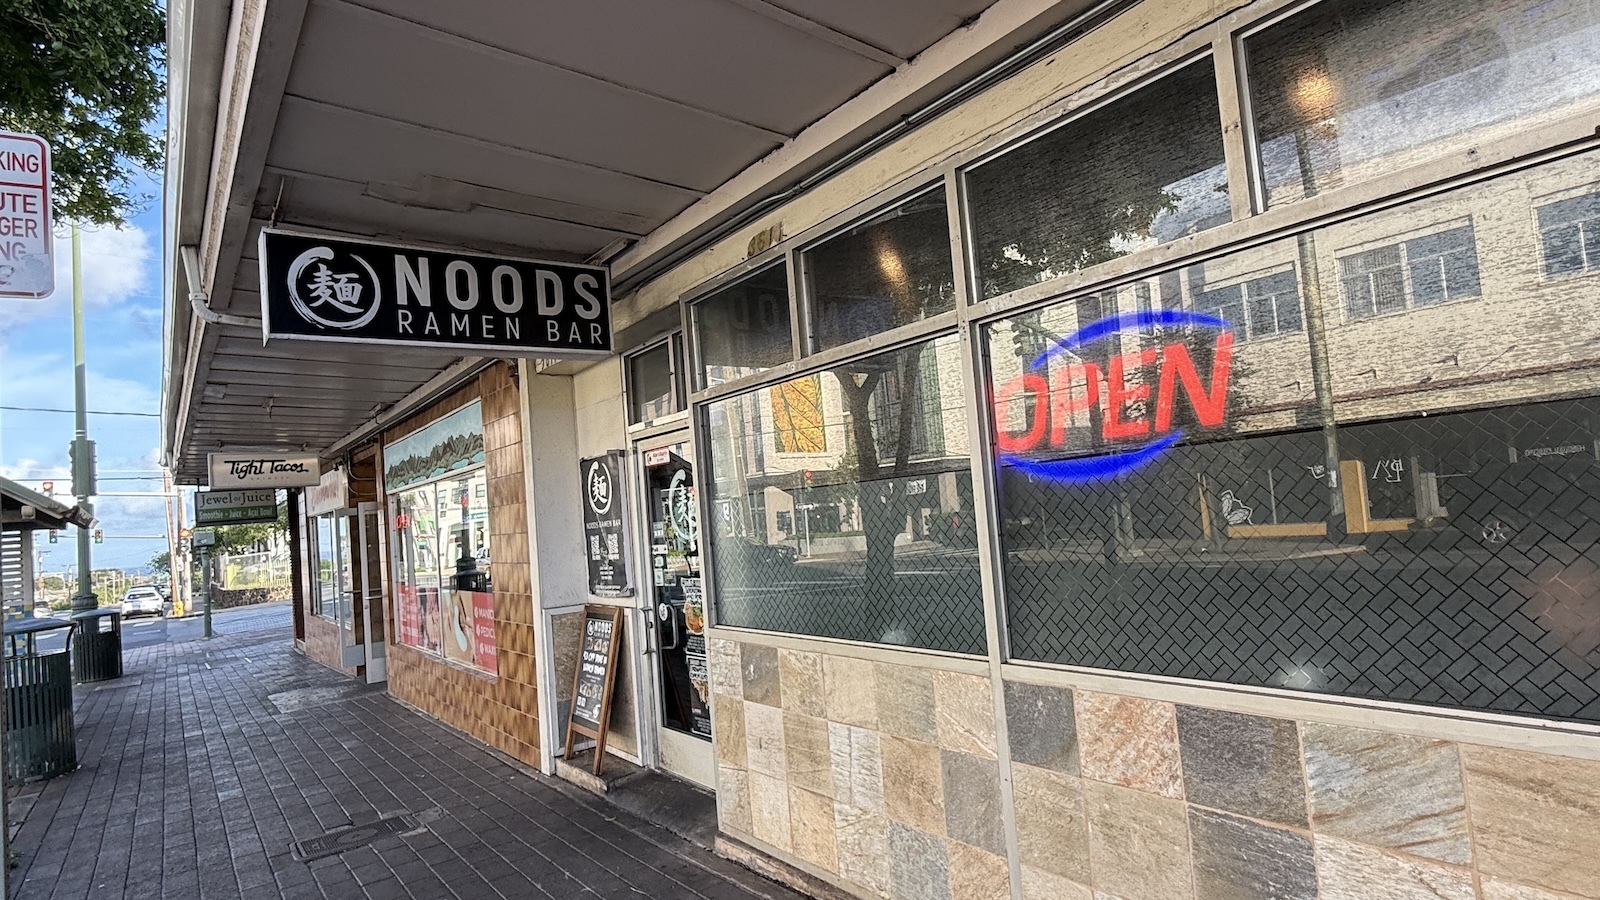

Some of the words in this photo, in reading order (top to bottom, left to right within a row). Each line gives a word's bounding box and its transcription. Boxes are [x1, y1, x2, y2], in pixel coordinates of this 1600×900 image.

[394, 254, 601, 320] NOODS
[398, 309, 521, 341] RAMEN
[547, 321, 603, 345] BAR
[994, 331, 1235, 453] OPEN
[224, 459, 265, 479] Tight
[260, 459, 309, 473] Tacos
[201, 492, 233, 508] Jewel
[240, 491, 271, 506] Juice
